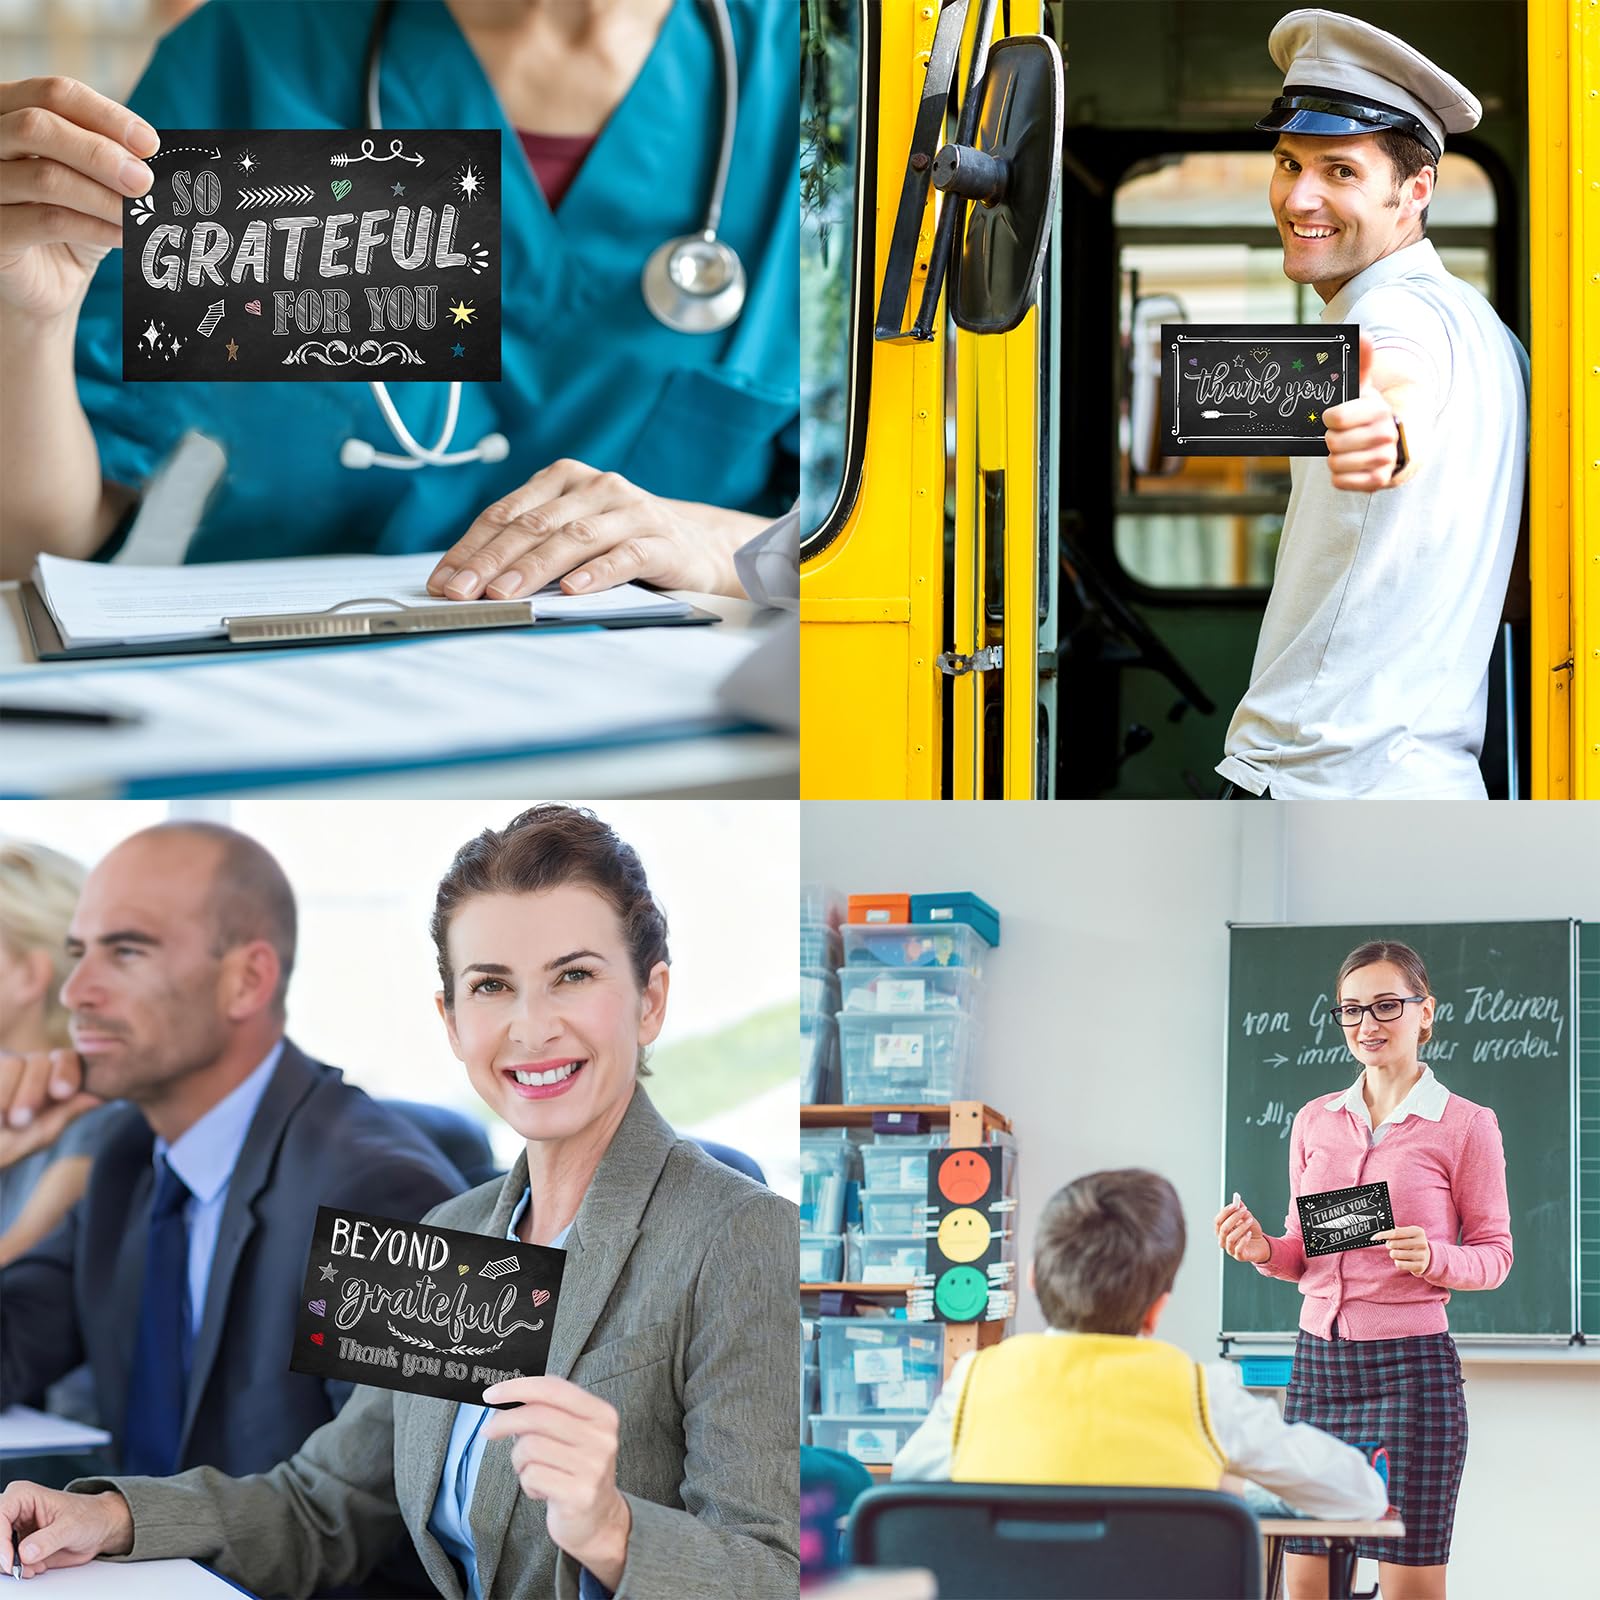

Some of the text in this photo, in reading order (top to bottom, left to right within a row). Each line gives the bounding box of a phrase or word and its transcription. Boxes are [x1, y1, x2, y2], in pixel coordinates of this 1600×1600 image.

[171, 170, 222, 216] SO
[141, 204, 471, 292] GRATEFUL
[272, 285, 439, 336] FOR YOU
[1184, 361, 1336, 418] thank you
[1313, 1197, 1368, 1224] THANK YOU
[1329, 1220, 1371, 1244] SO MUCH
[330, 1218, 450, 1272] BEYOND
[334, 1274, 545, 1343] grateful
[338, 1336, 401, 1369] Thank
[401, 1352, 442, 1377] you
[443, 1360, 469, 1381] so
